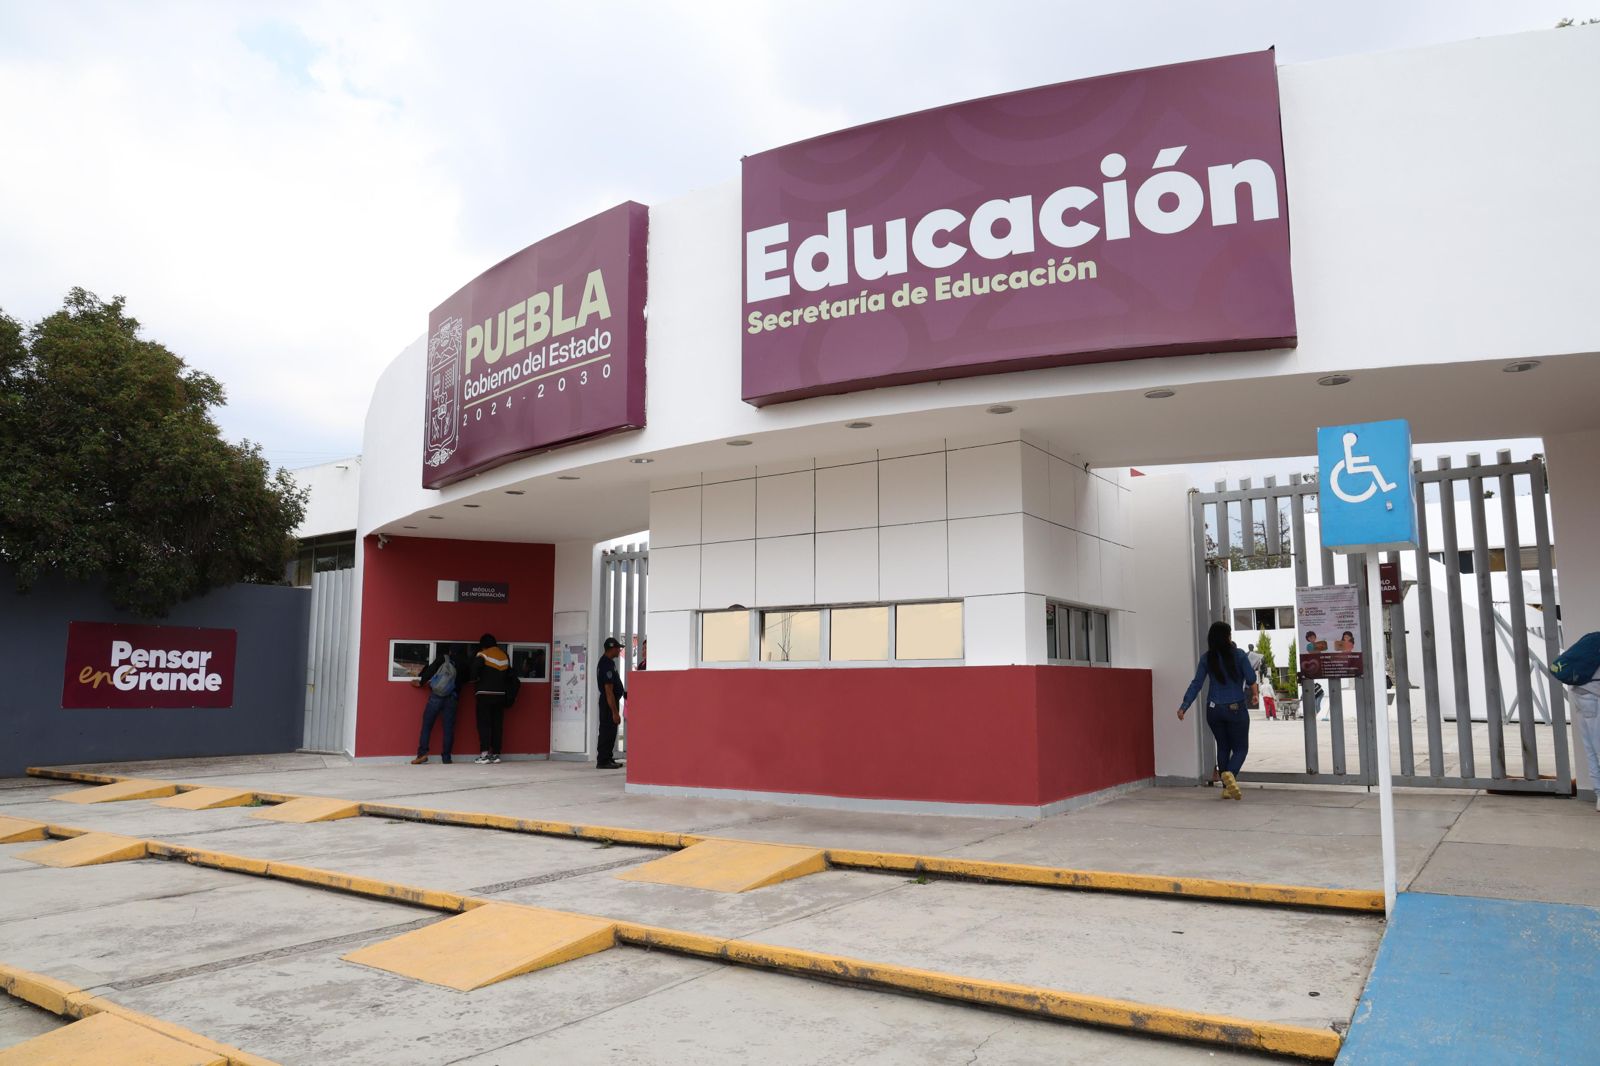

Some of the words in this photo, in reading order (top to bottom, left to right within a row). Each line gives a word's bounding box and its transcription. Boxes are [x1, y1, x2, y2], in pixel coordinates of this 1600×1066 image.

[746, 145, 1279, 303] Educación
[464, 268, 611, 374] PUEBLA
[747, 289, 885, 334] Secretaría
[892, 282, 928, 308] de
[935, 257, 1097, 301] Educación
[464, 360, 520, 400] Gobierno
[522, 346, 546, 376] del
[549, 328, 611, 364] Estado
[79, 665, 114, 689] en
[113, 665, 222, 691] Grande
[111, 640, 212, 668] Pensar
